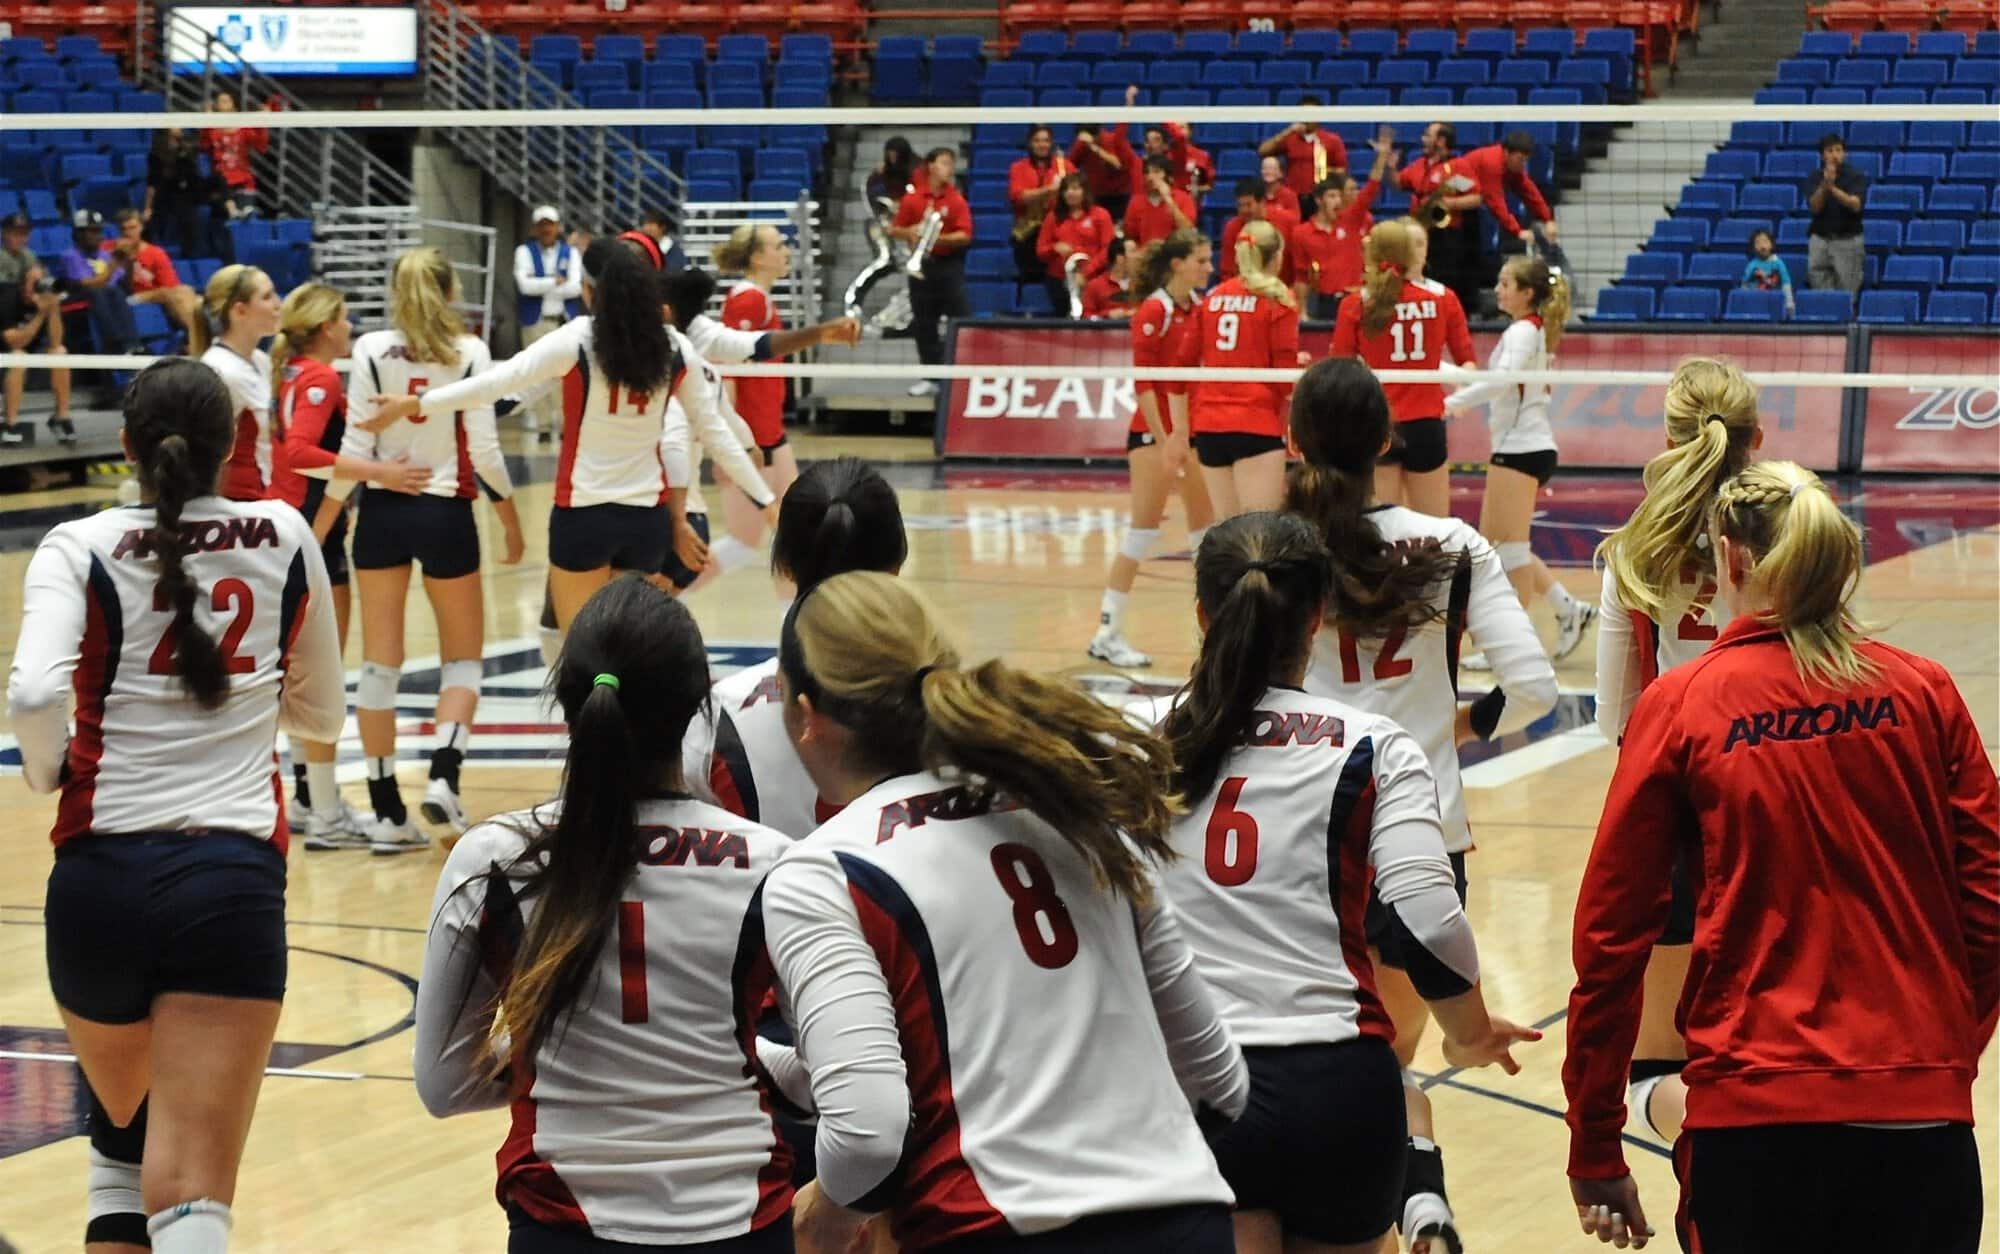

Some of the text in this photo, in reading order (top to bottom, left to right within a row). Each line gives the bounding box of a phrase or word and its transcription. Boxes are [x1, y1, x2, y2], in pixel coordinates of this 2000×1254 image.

[1208, 295, 1258, 312] UTAH
[1215, 312, 1239, 351] 9
[1394, 300, 1437, 320] TAH
[1390, 321, 1427, 361] 11
[148, 577, 256, 676] 22
[1723, 697, 1899, 753] ARIZONA
[1205, 777, 1259, 887] 6
[990, 842, 1079, 970] 8
[619, 901, 648, 1024] 1
